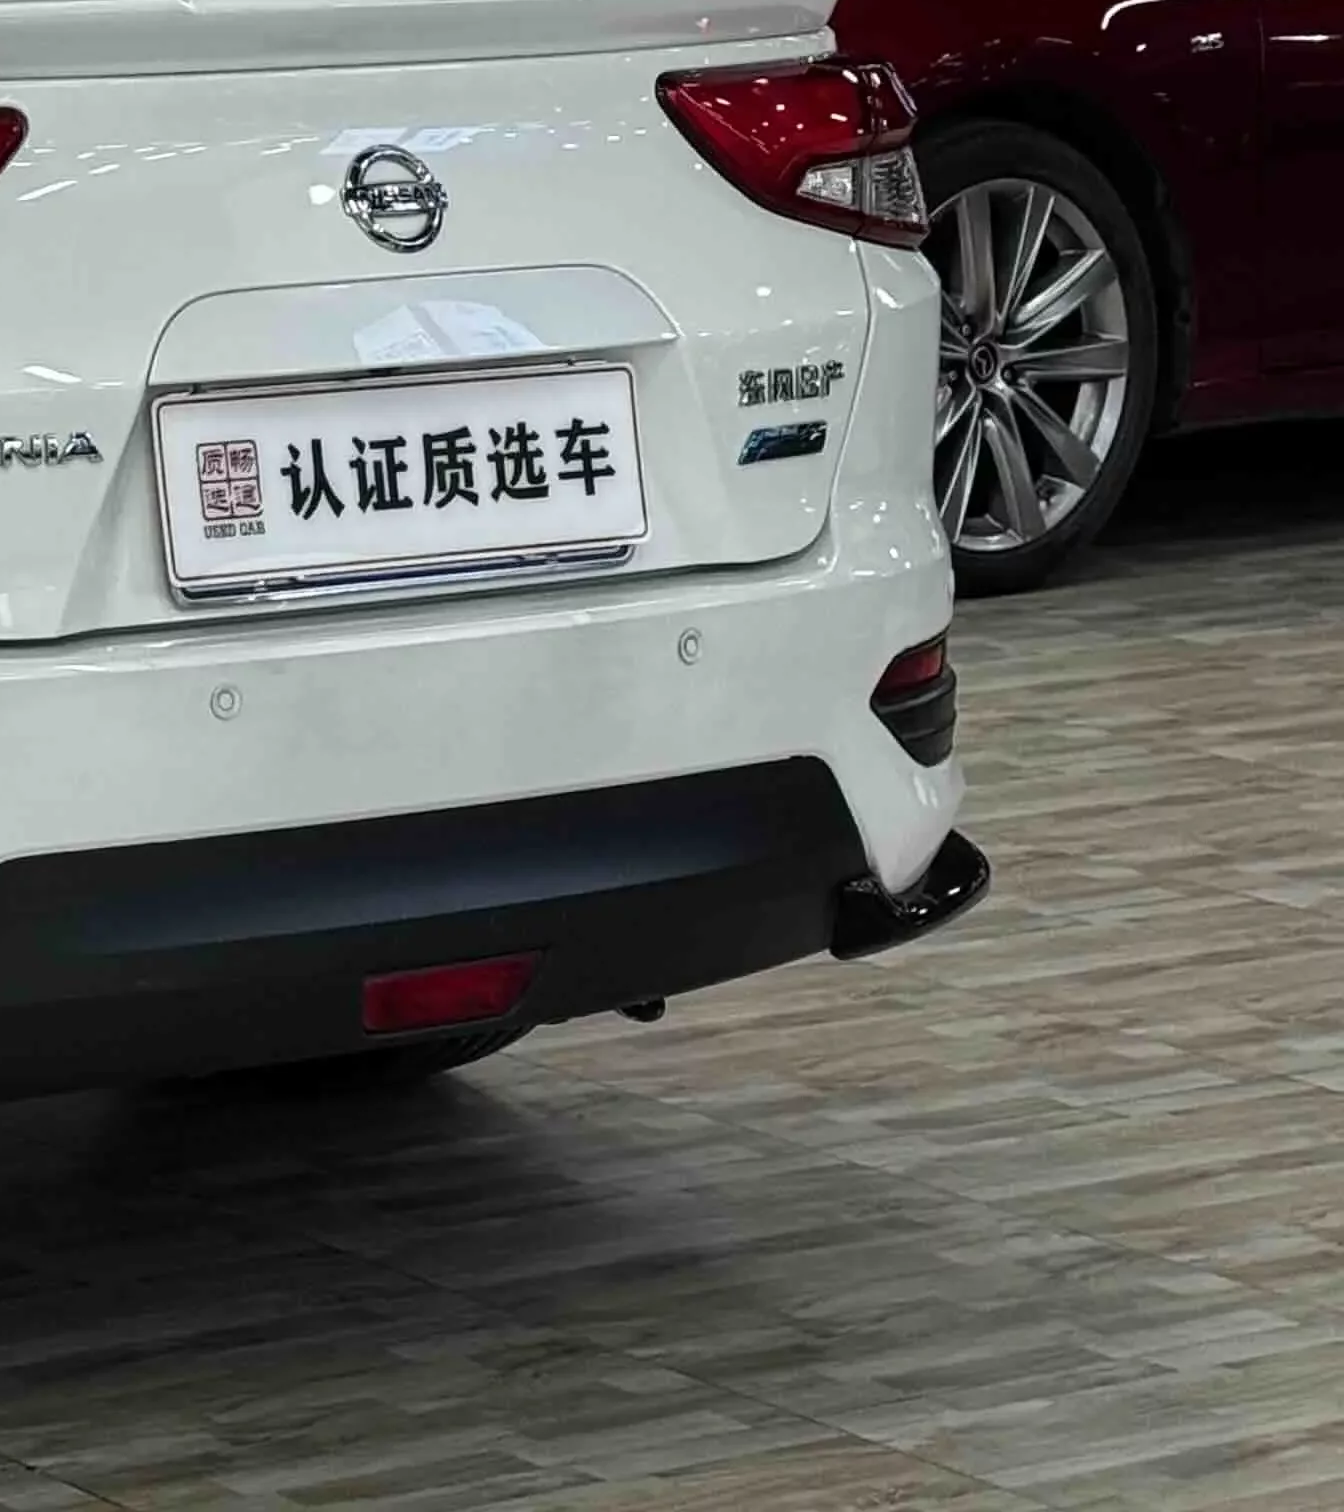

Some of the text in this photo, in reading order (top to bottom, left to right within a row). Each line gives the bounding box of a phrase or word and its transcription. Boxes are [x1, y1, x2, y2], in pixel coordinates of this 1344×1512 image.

[279, 417, 617, 521] 认证质选车
